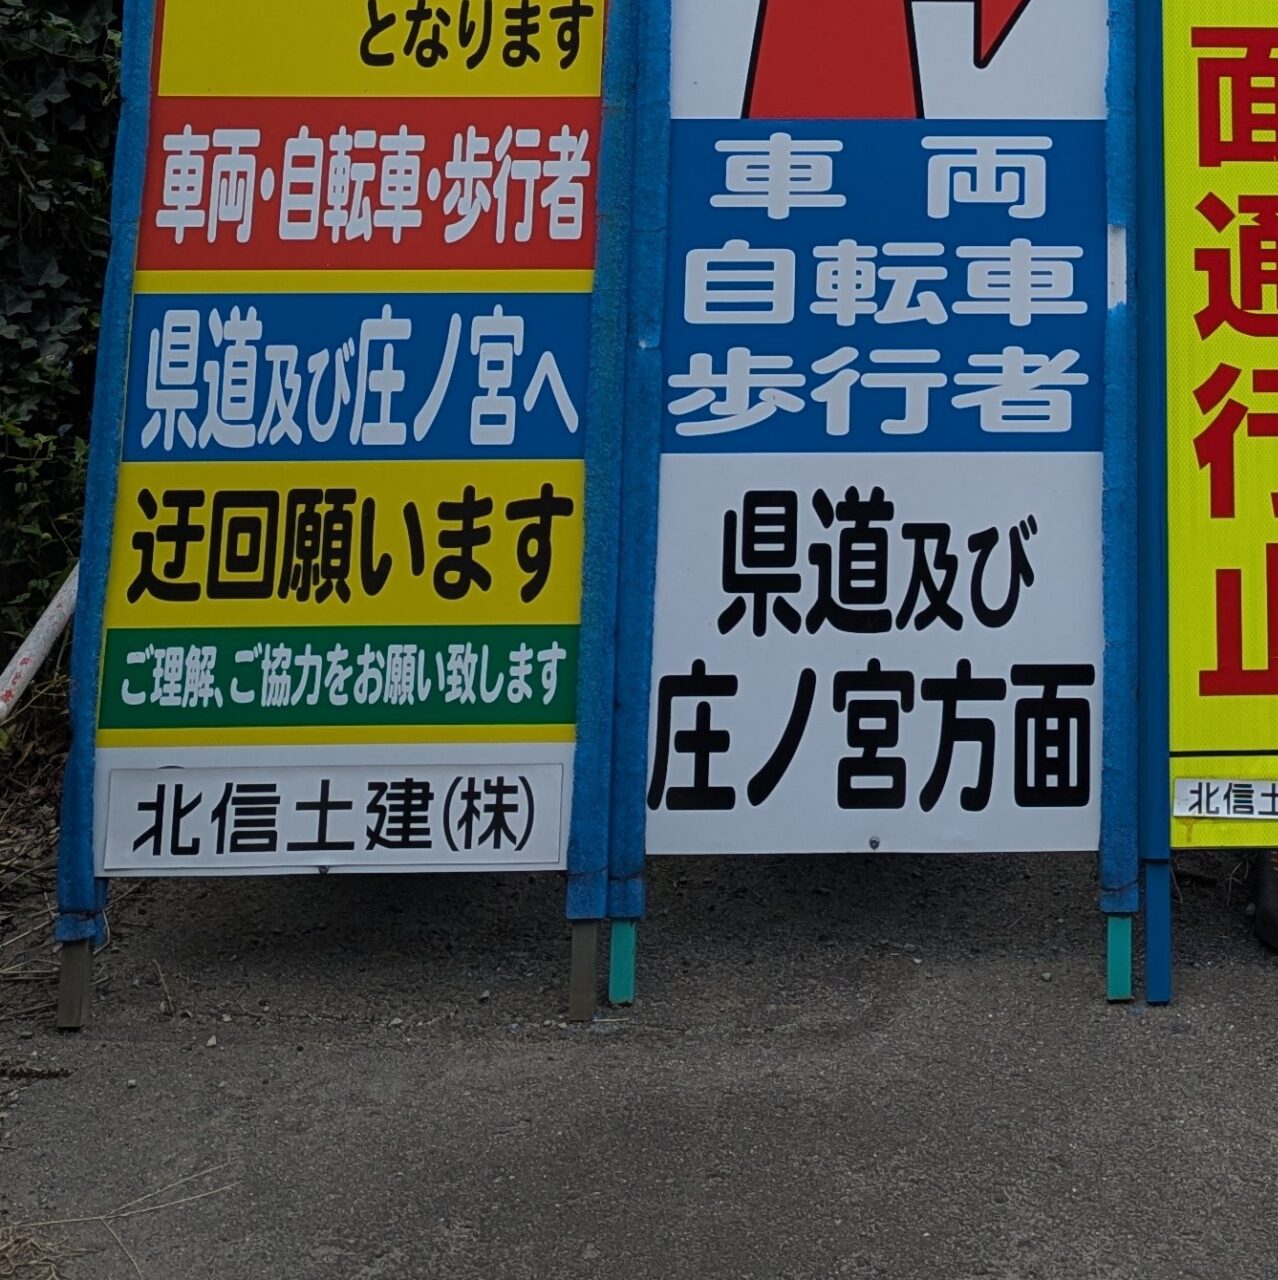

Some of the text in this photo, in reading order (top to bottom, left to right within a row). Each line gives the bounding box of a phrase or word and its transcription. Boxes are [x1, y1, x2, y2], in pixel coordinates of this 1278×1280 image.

[683, 238, 1088, 326] 自転車
[141, 303, 579, 451] 県道及び庄ノ宮へ
[667, 346, 1089, 436] 歩行者
[126, 483, 574, 604] 迂回願います
[717, 485, 1038, 637] 県道及び
[646, 658, 1095, 812] 庄ノ宮方面
[132, 775, 536, 857] 北信土建(株)
